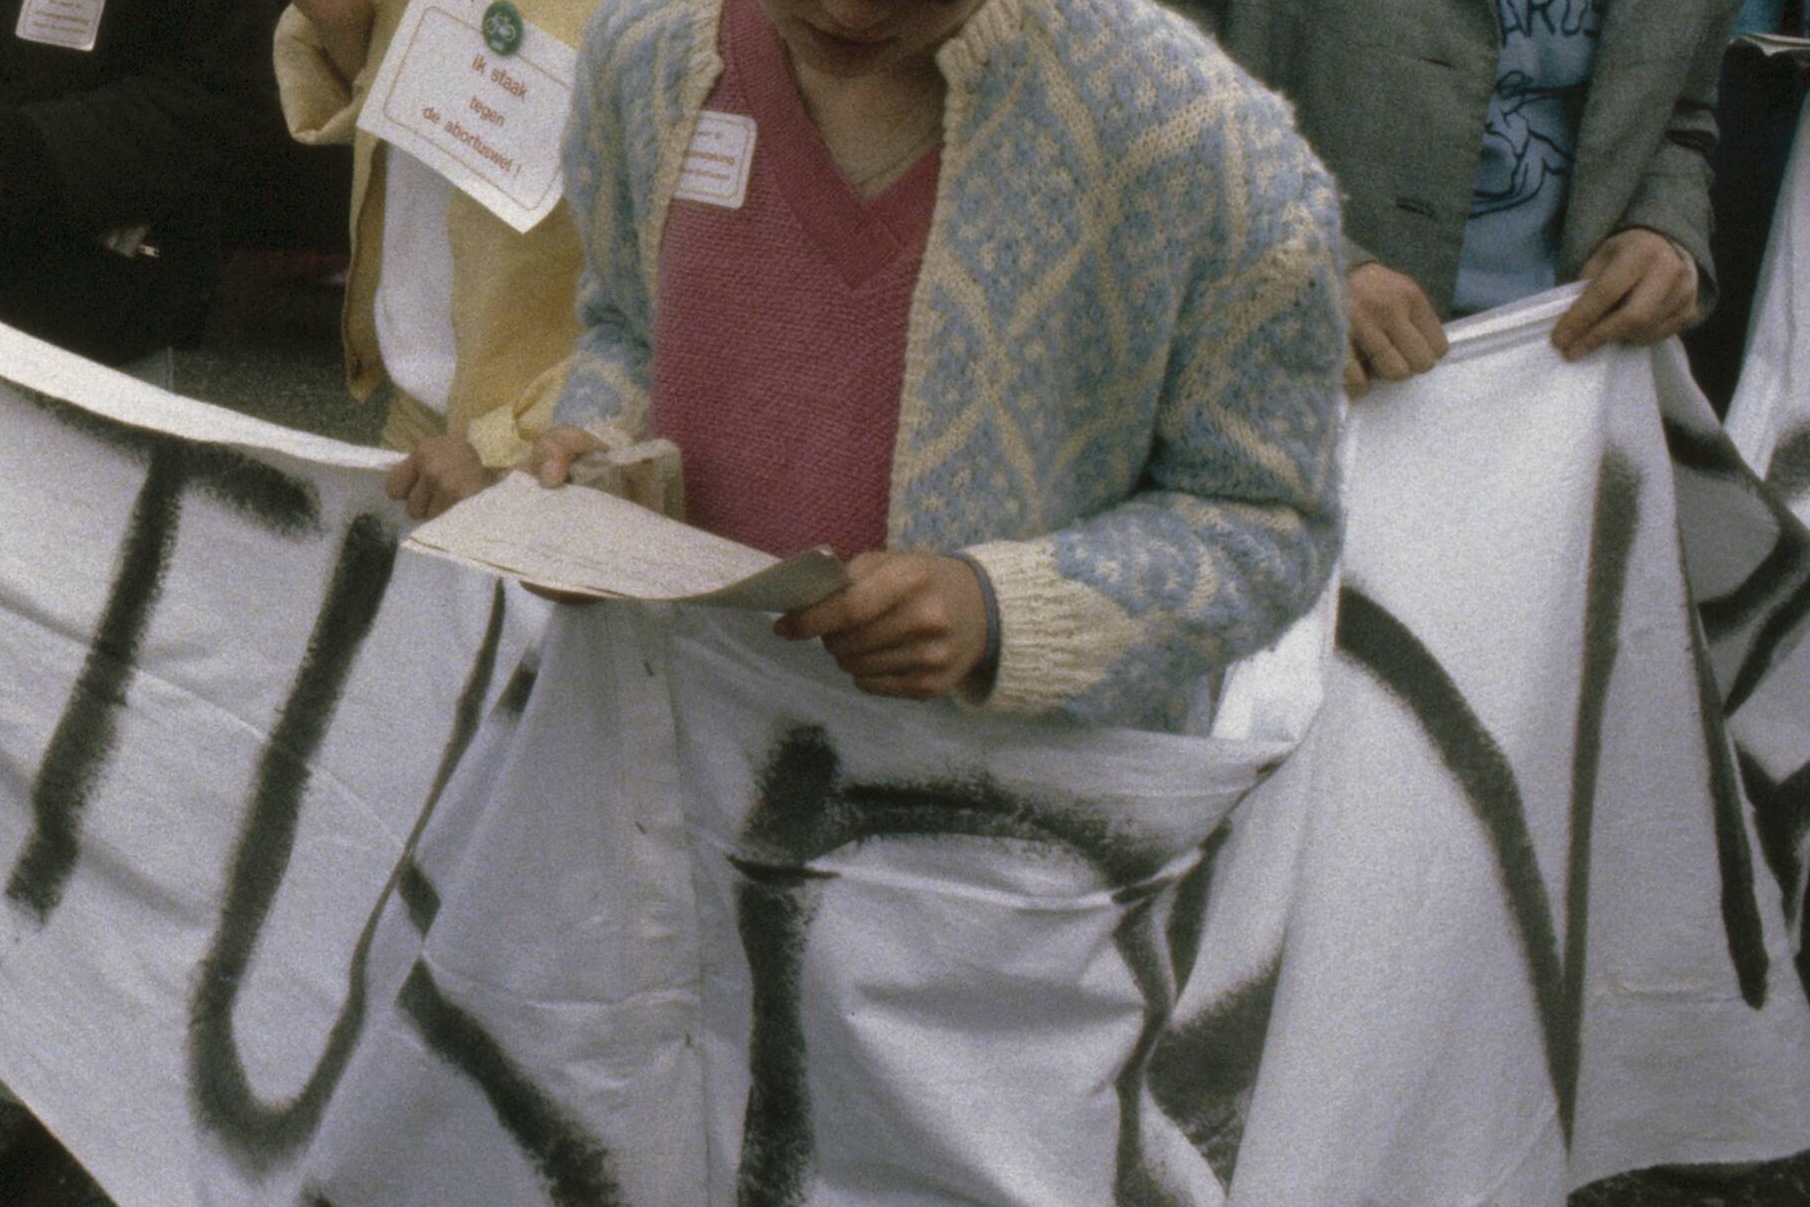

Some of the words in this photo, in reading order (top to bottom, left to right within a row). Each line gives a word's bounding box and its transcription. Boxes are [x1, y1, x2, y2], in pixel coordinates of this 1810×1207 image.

[491, 67, 528, 102] staak
[422, 106, 441, 124] de
[469, 95, 506, 127] tegen
